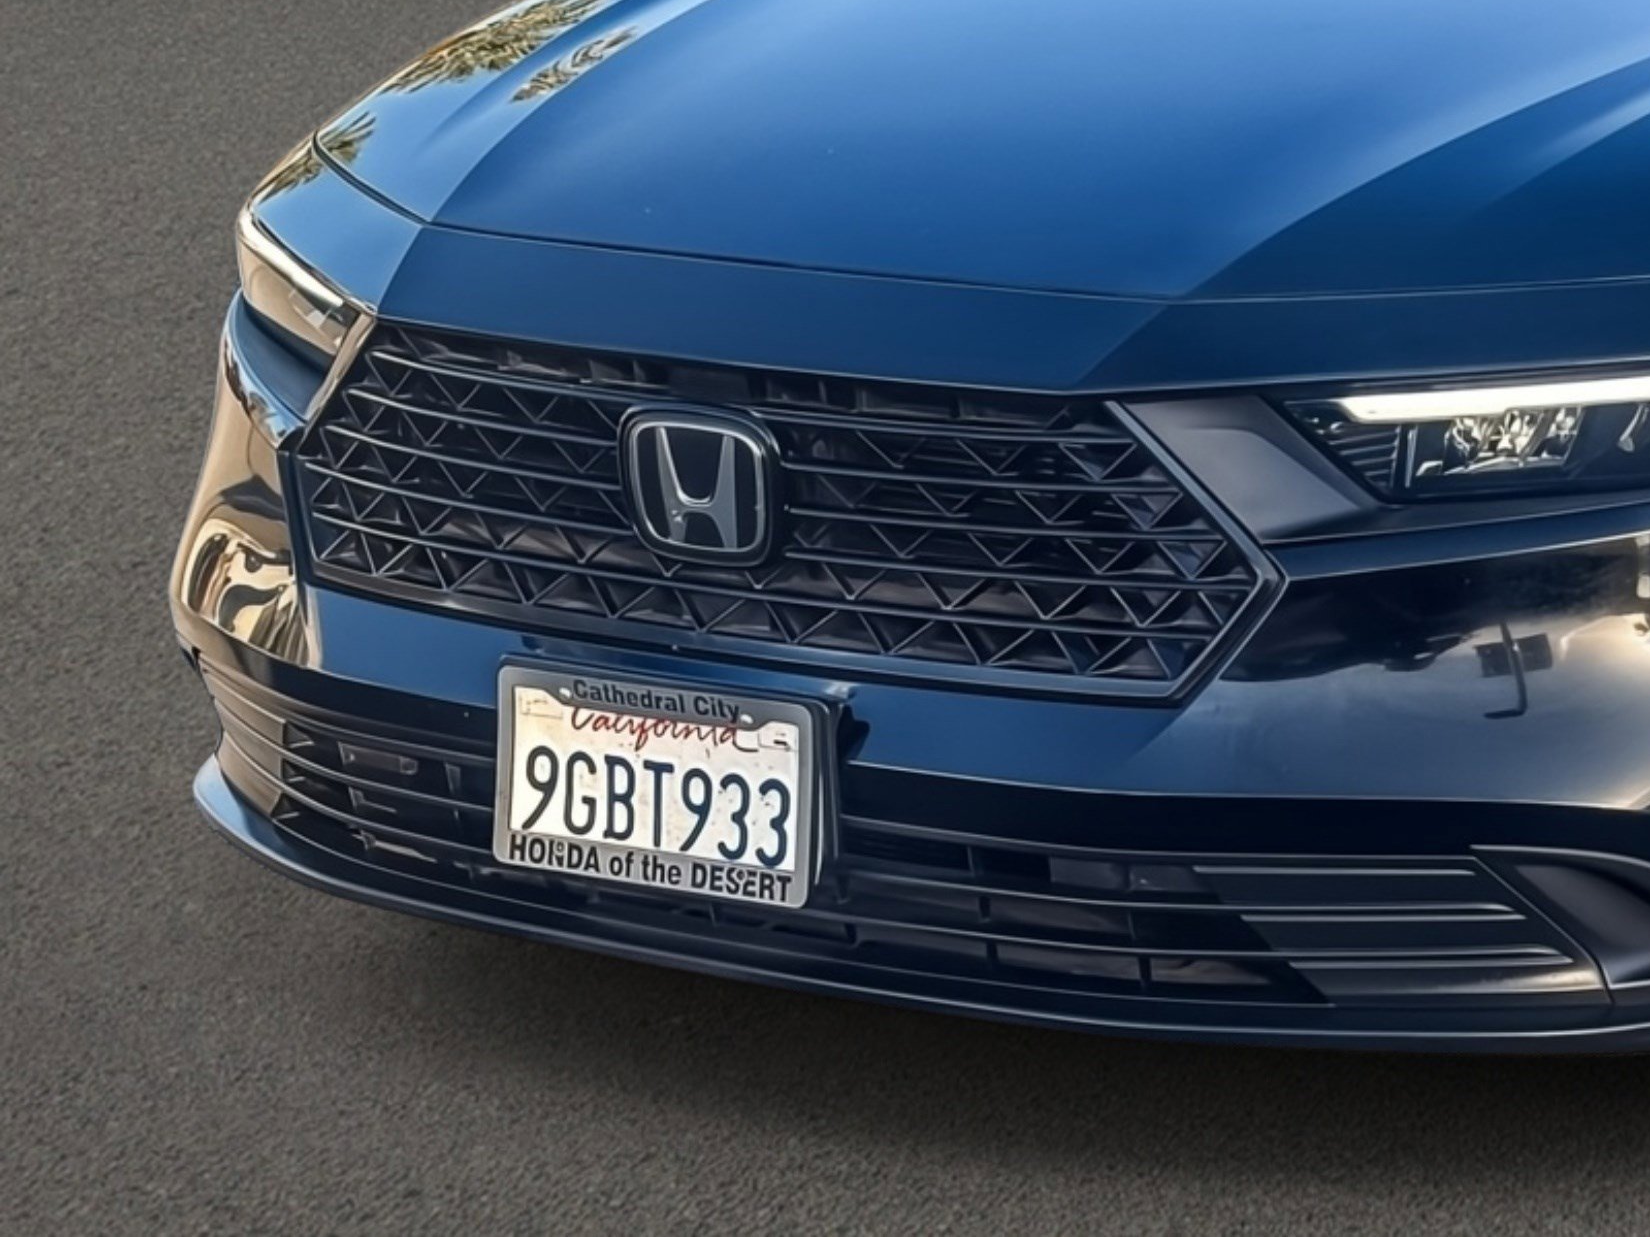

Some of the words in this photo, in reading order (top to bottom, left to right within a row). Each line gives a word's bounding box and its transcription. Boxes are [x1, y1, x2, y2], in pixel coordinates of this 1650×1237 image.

[572, 678, 687, 715] Cathedral
[693, 695, 741, 723] City
[520, 745, 792, 869] 9GBT933
[509, 833, 601, 873] HONDA
[609, 851, 635, 878] of
[641, 857, 682, 886] the
[690, 863, 793, 904] DESERT
